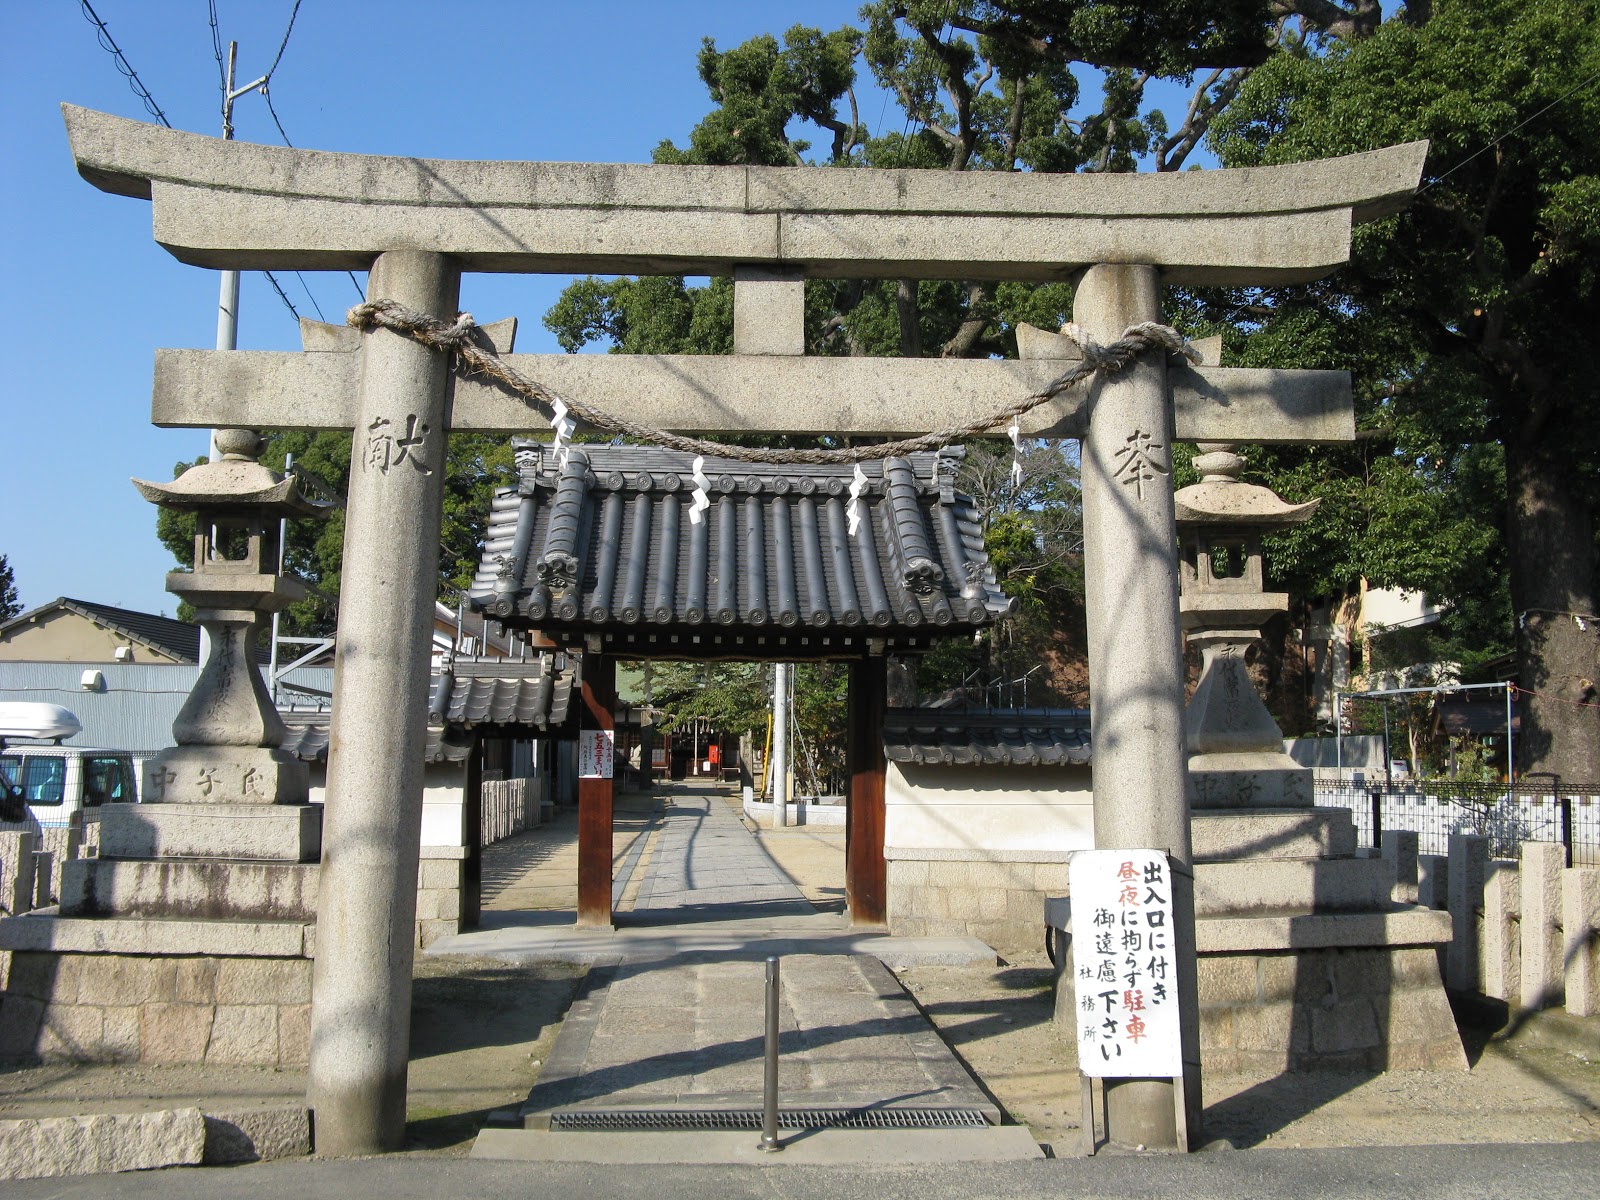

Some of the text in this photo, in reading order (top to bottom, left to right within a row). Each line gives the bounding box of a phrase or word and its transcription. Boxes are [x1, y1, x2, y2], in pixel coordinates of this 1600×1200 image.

[1113, 429, 1170, 501] 奉
[594, 733, 604, 776] 七五三まいり
[1093, 907, 1122, 1061] 御遠慮下さい
[1116, 861, 1147, 1044] 昼夜に拘らず駐車
[1143, 861, 1169, 1005] 出入口に付き
[1079, 964, 1097, 1042] 社務所
